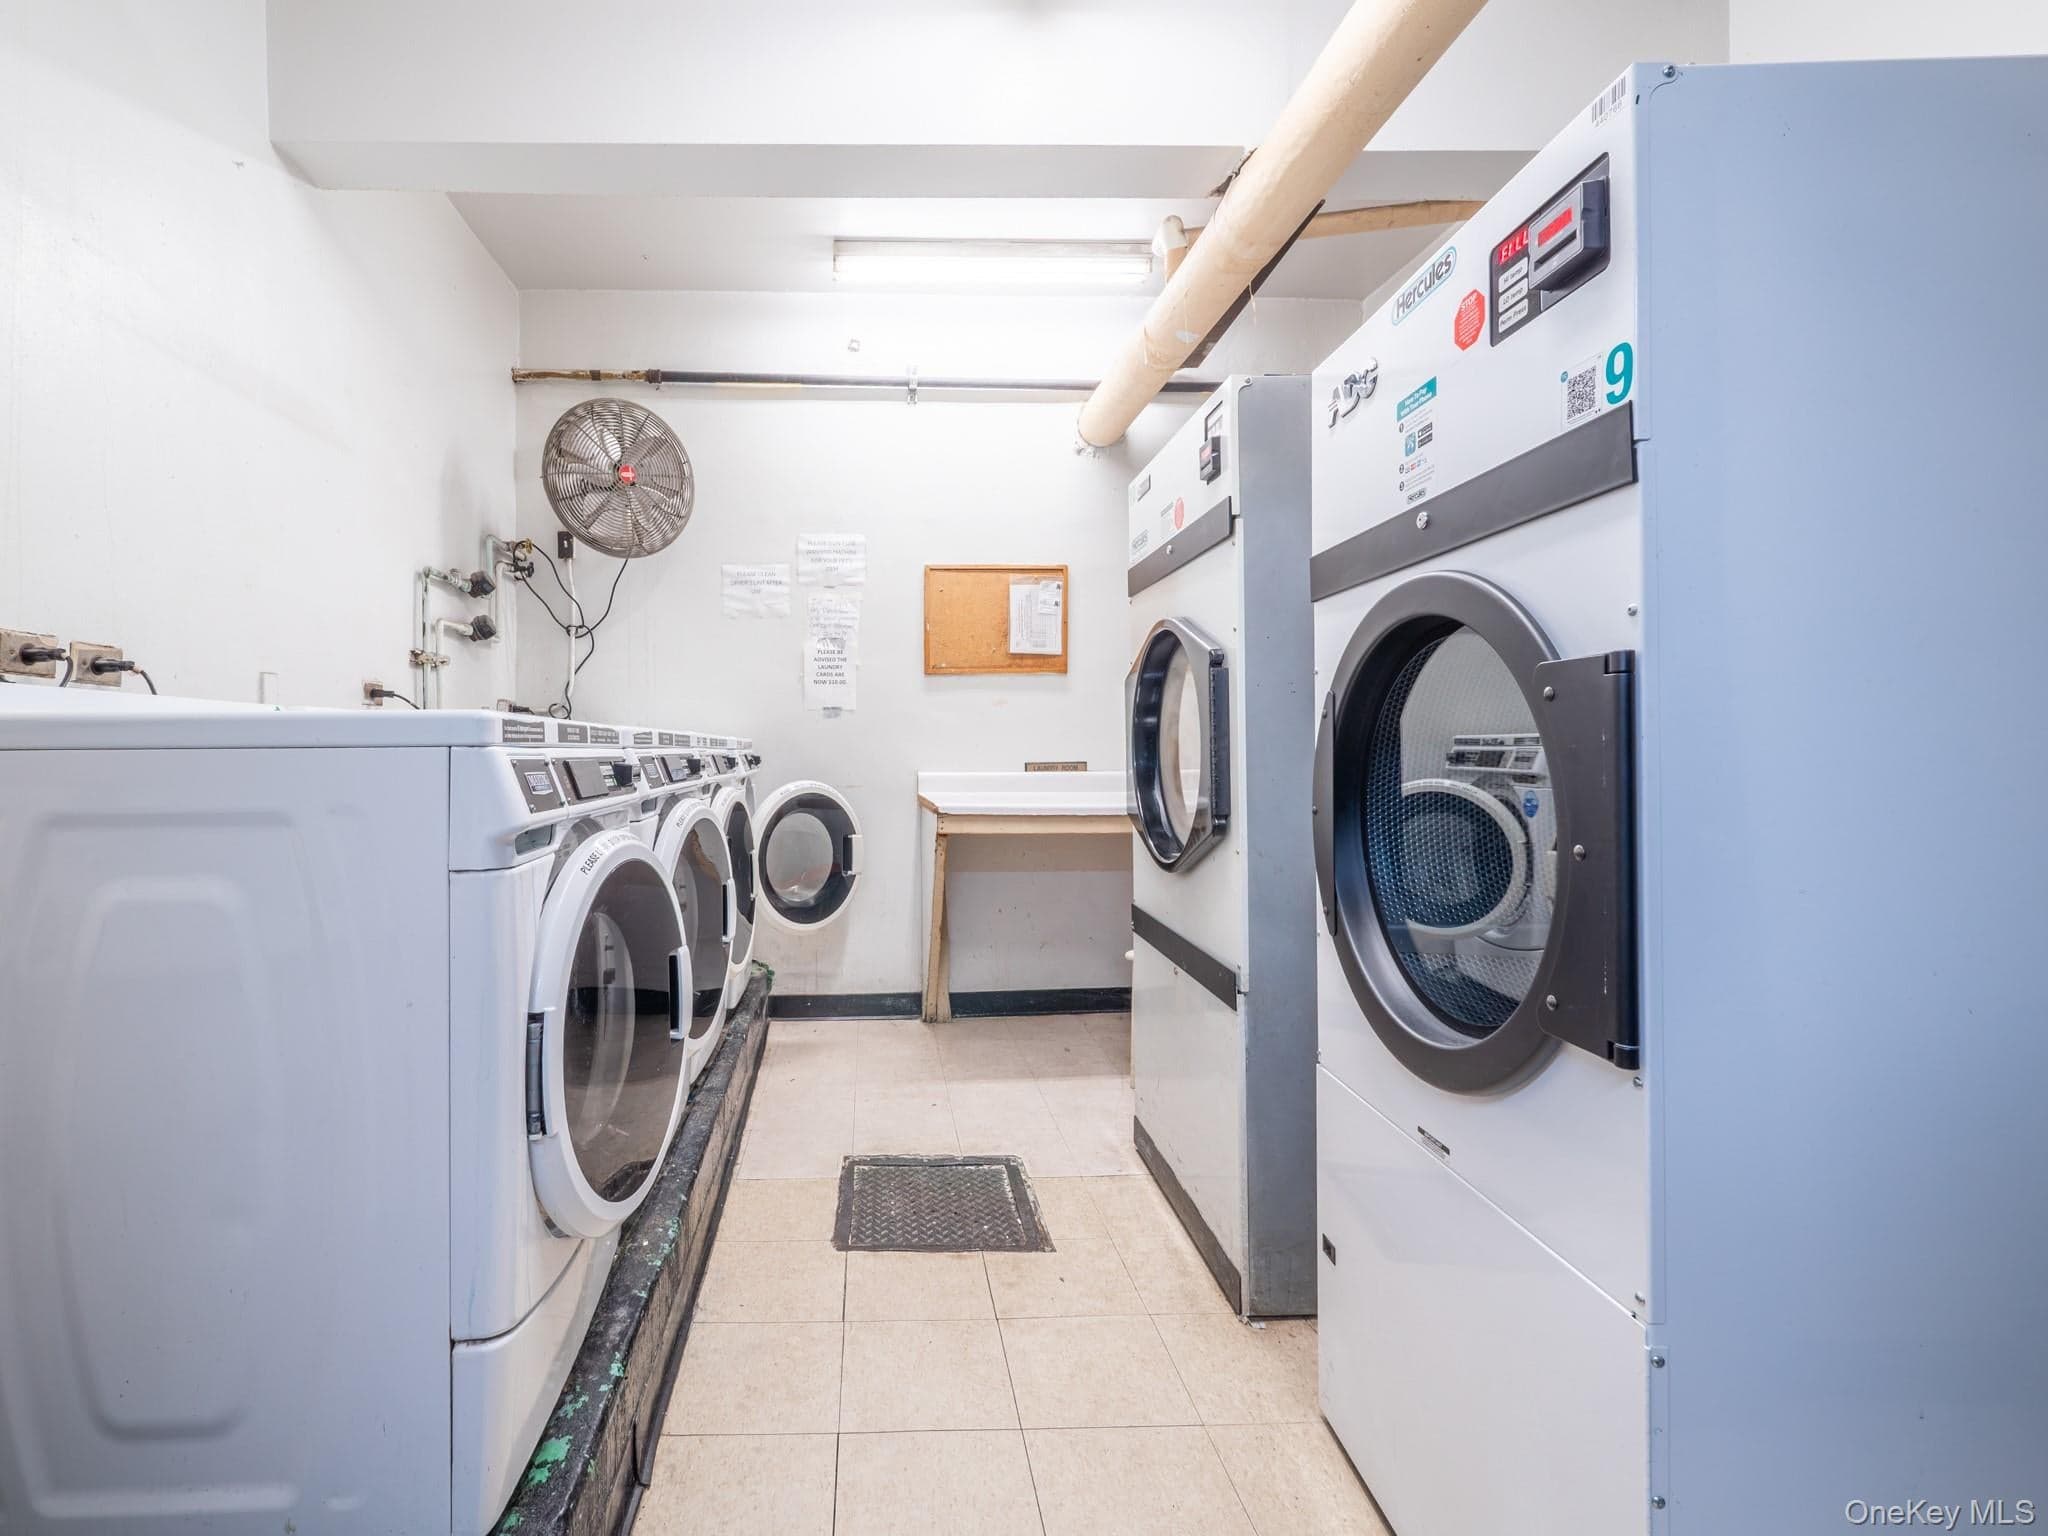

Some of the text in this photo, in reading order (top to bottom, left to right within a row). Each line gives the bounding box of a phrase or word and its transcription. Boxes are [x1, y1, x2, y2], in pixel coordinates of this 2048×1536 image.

[1396, 254, 1452, 319] Hercules
[1606, 342, 1633, 404] 9
[1061, 764, 1079, 772] ROOM
[580, 852, 599, 875] PLEASE
